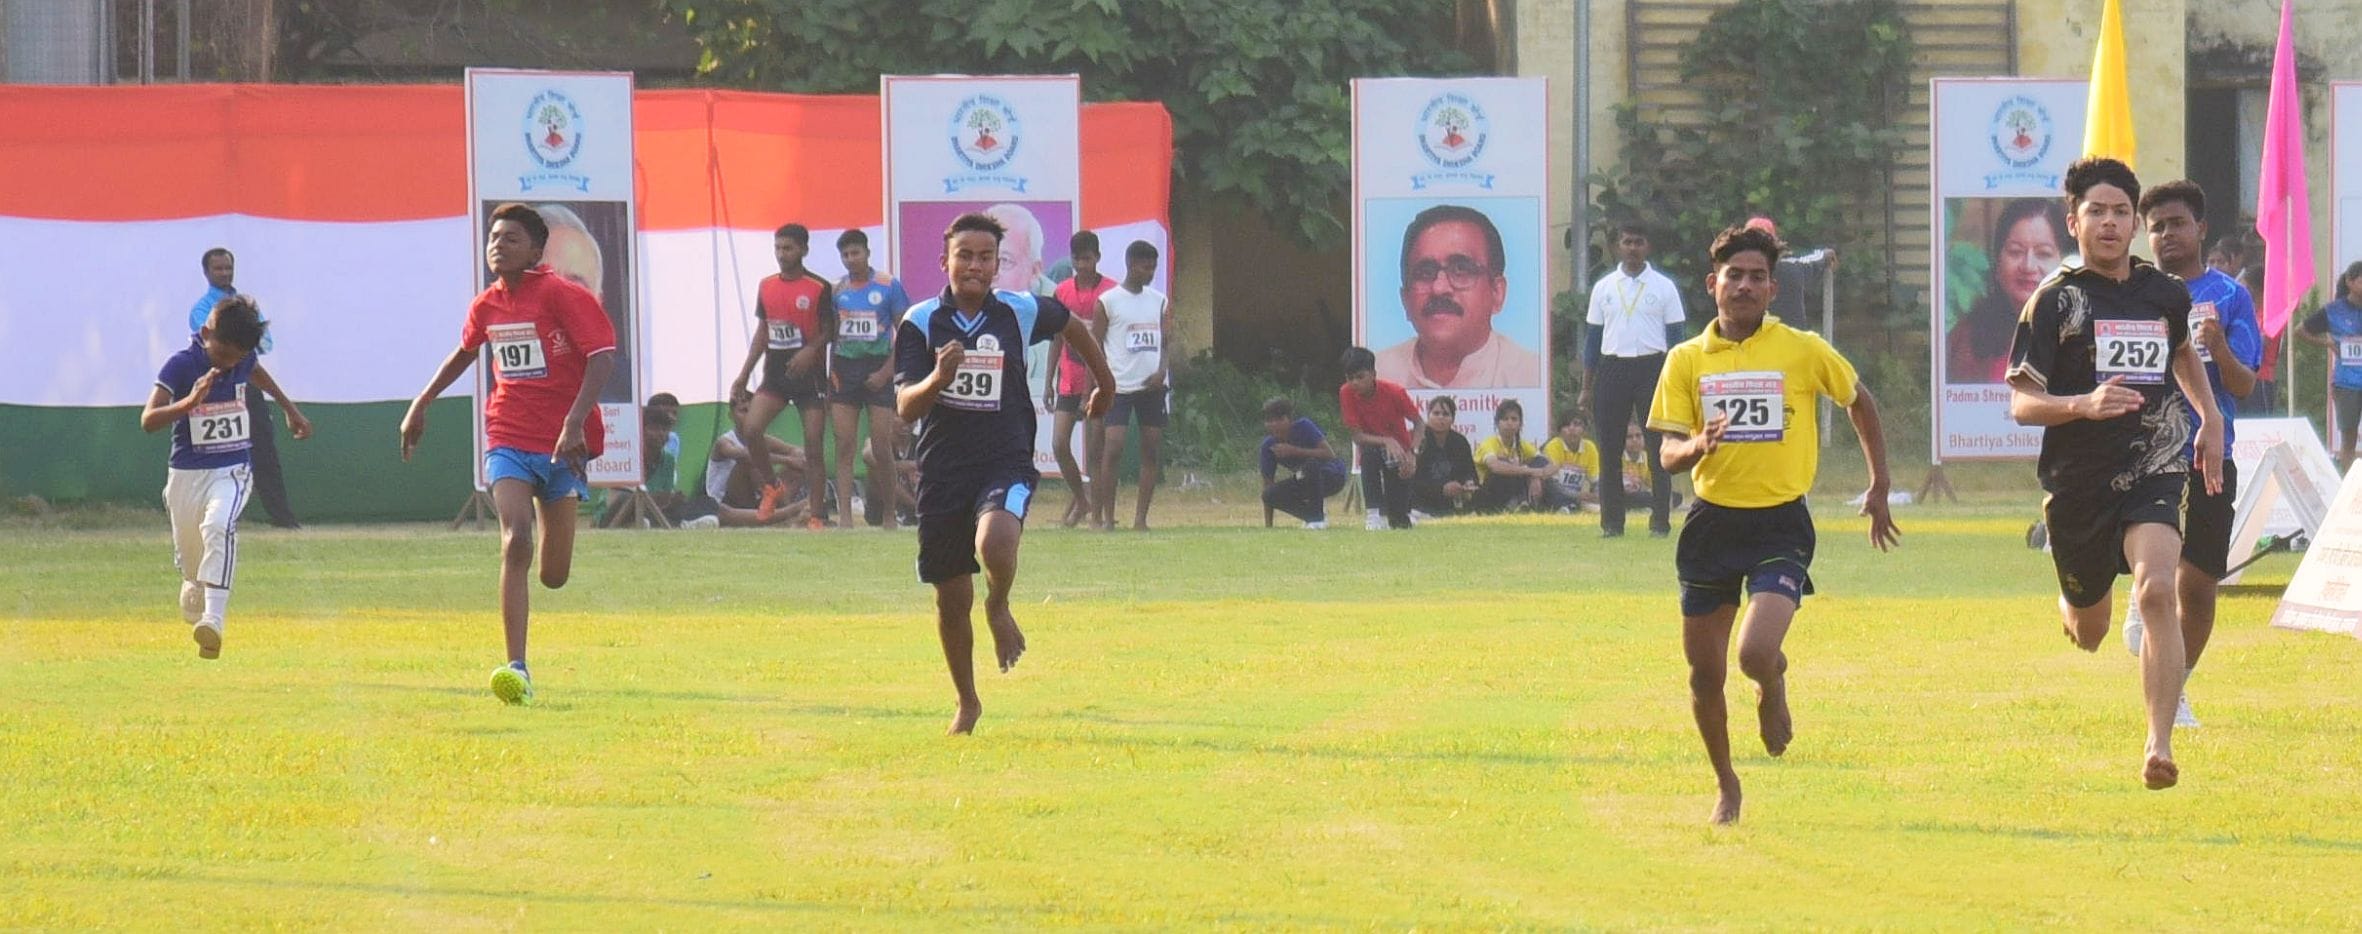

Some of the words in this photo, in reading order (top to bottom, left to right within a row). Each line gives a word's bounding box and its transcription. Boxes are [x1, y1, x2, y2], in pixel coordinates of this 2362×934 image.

[846, 320, 871, 334] 210
[1132, 332, 1155, 346] 241
[499, 344, 531, 368] 197
[2108, 340, 2160, 368] 252
[944, 372, 993, 397] 39
[1946, 390, 1979, 402] Padma
[1713, 398, 1769, 426] 125
[201, 415, 243, 441] 231
[1949, 433, 2002, 451] Bhartiya
[2006, 432, 2043, 447] Shiks
[596, 458, 632, 472] Board
